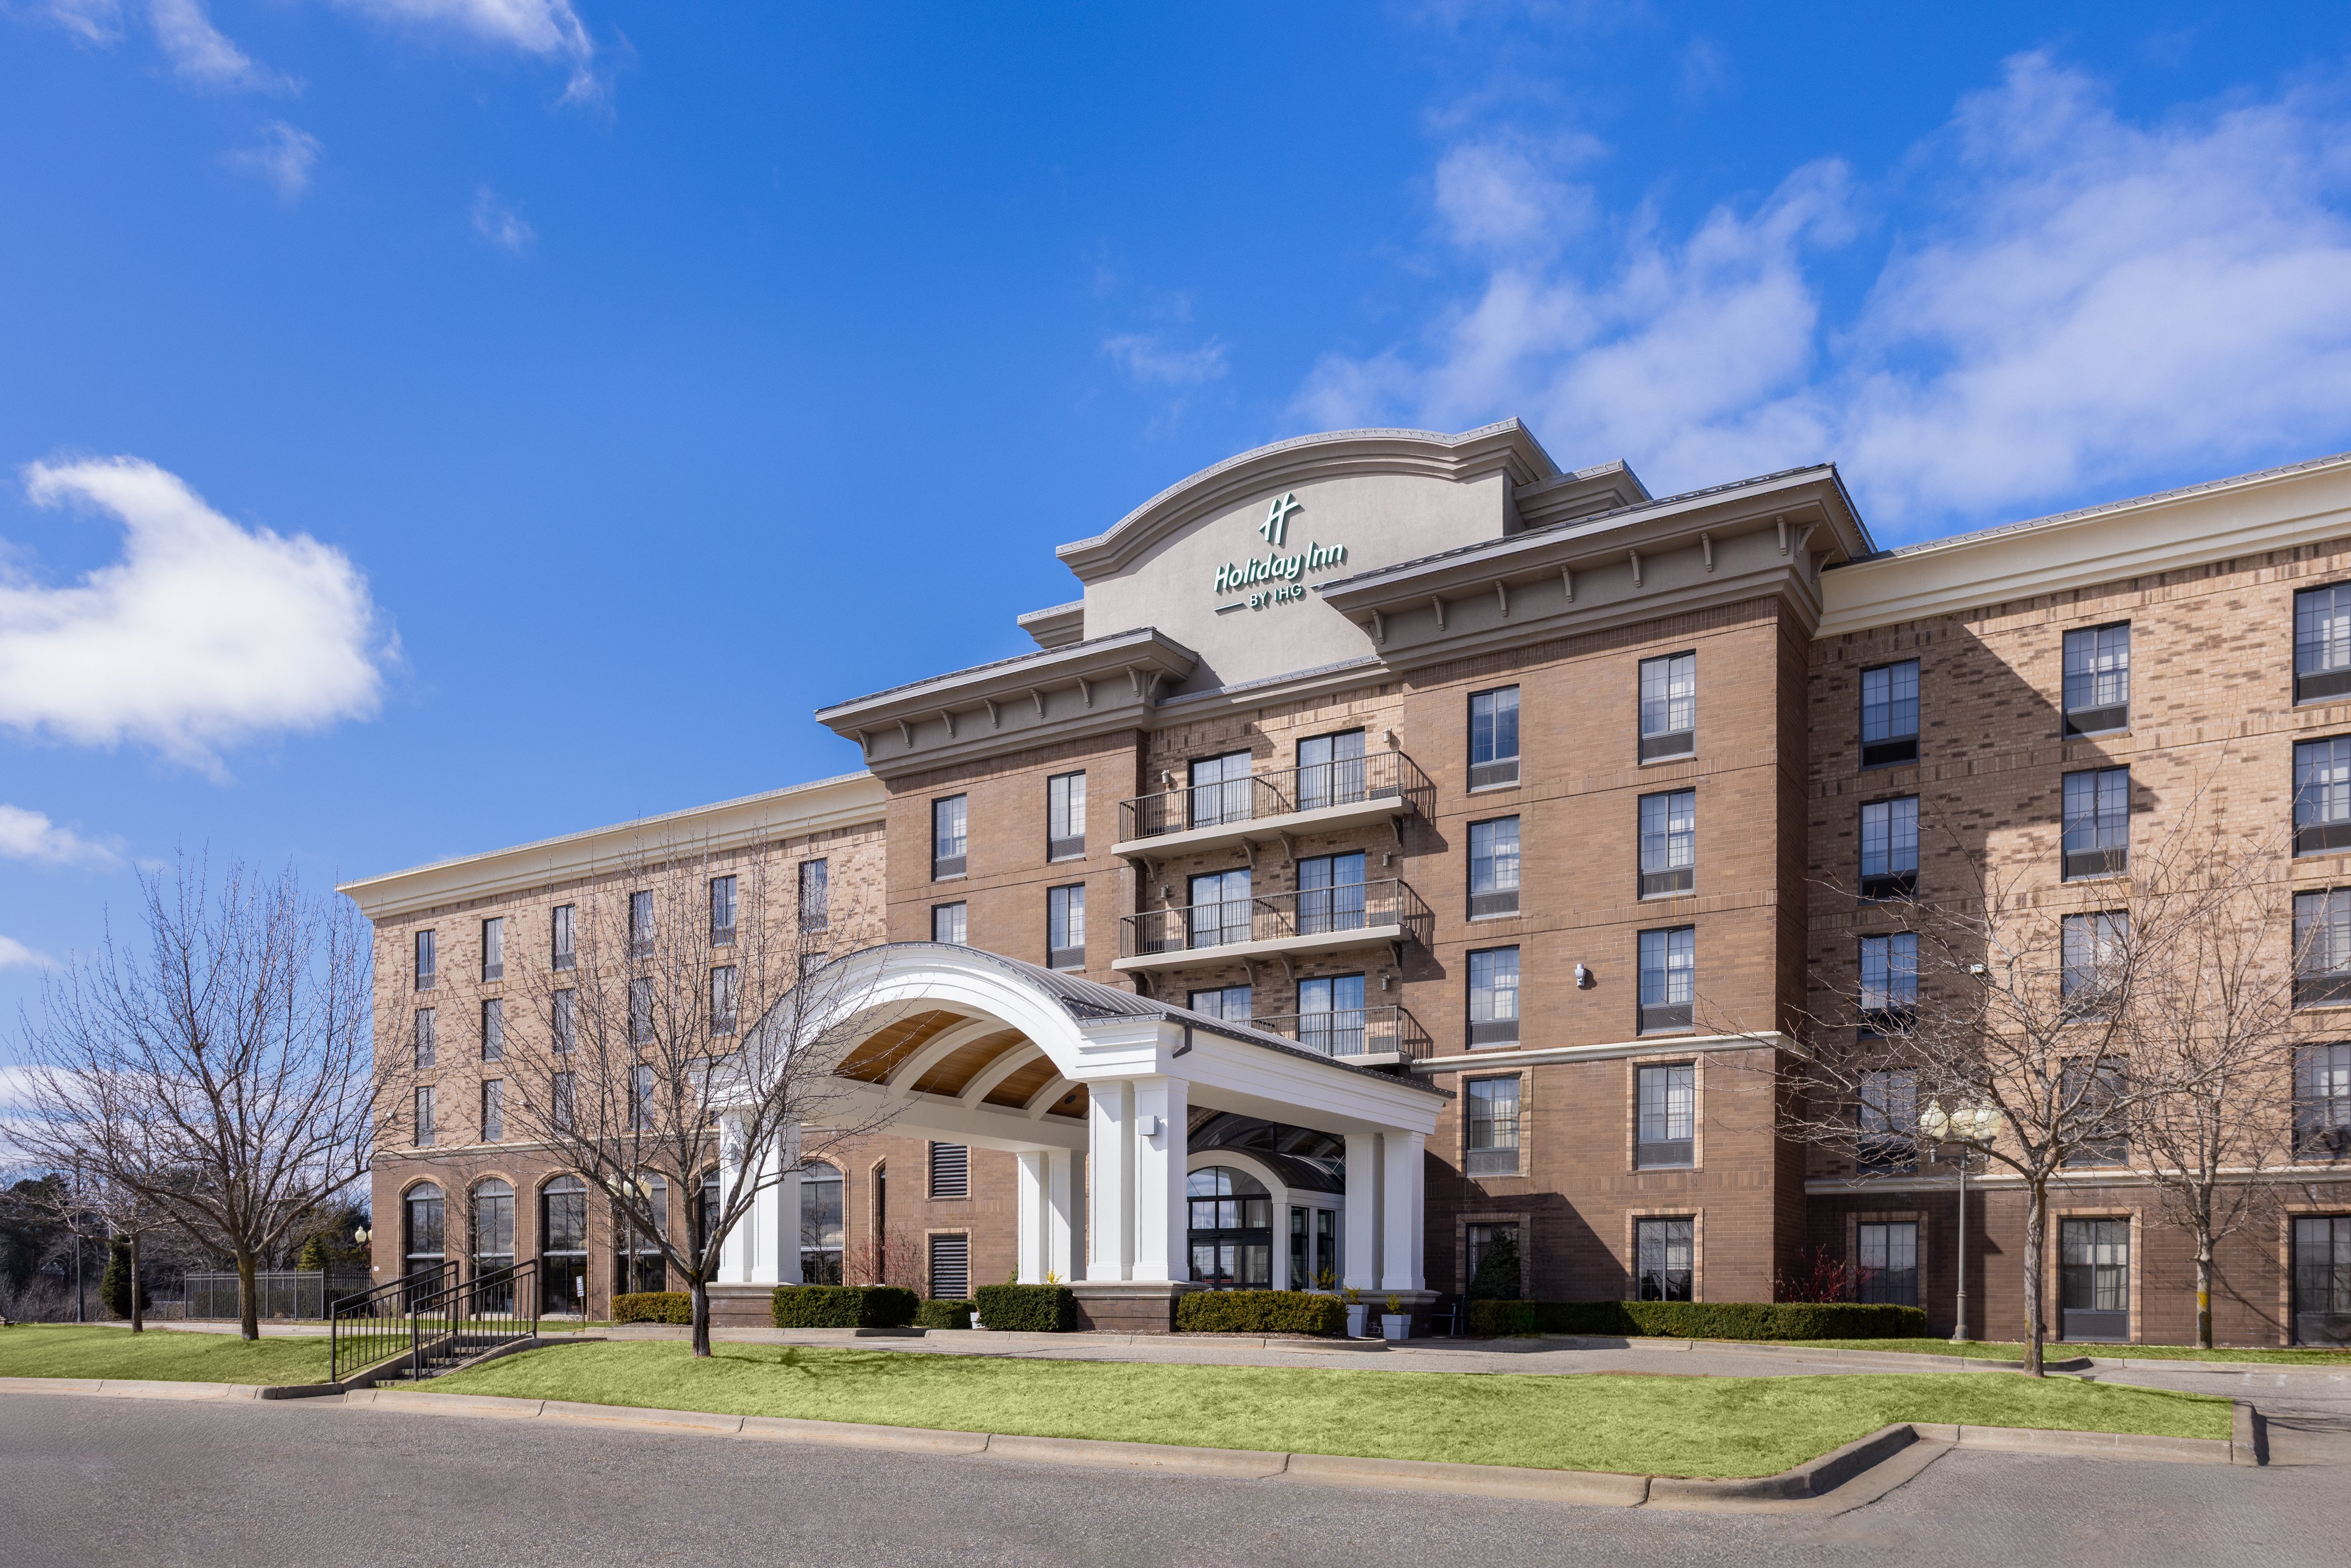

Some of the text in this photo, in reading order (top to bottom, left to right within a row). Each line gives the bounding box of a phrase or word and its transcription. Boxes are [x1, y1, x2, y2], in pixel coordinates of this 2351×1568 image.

[1258, 492, 1300, 544] H
[1213, 540, 1343, 592] Holiday Inn
[1249, 583, 1302, 607] BY IHG
